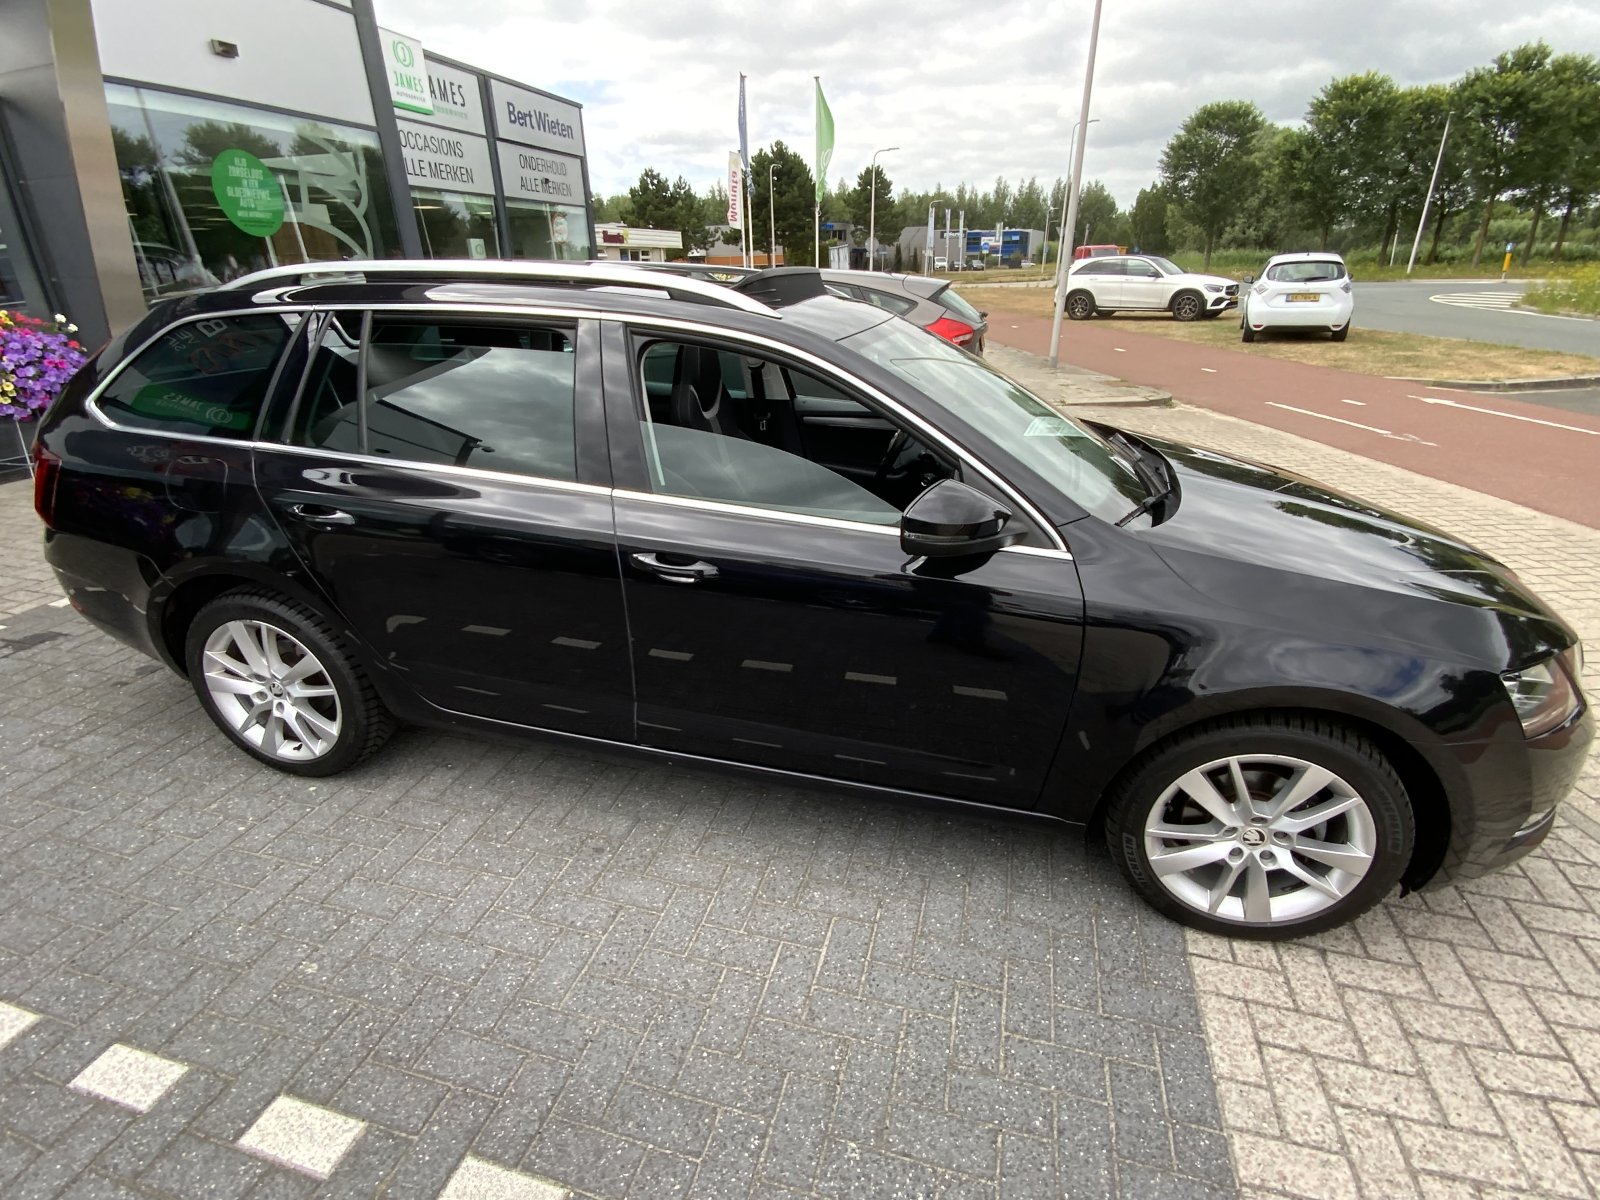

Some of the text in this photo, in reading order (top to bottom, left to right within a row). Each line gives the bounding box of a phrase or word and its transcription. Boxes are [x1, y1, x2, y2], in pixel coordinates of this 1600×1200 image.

[393, 70, 424, 93] JAMES
[428, 75, 465, 107] AMES
[507, 101, 574, 139] Bert Wieten
[399, 129, 464, 158] OCCASIONS
[404, 157, 474, 184] LLE MERKEN
[519, 153, 567, 176] ONDERHOUD
[520, 176, 540, 193] ALLE
